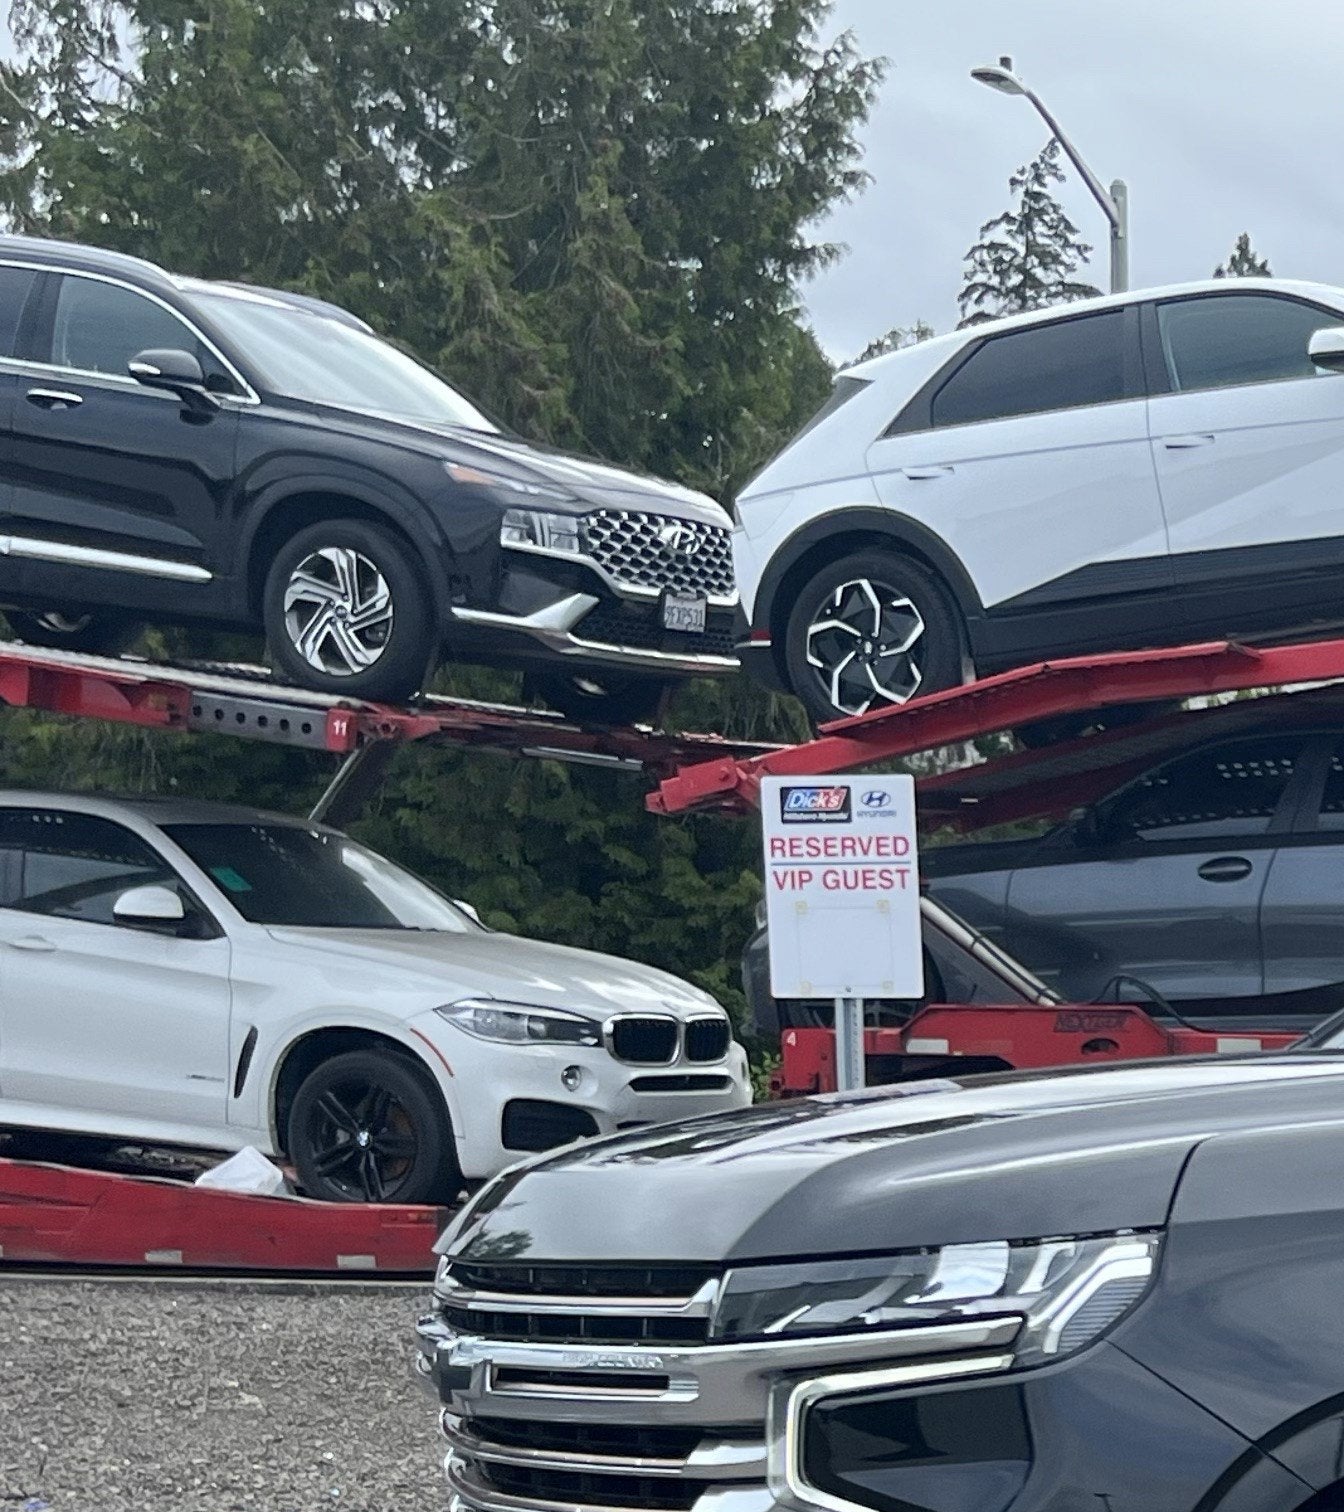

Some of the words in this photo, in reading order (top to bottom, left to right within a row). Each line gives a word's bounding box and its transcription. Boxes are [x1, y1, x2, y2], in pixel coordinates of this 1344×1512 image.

[333, 720, 347, 736] 11
[770, 835, 910, 857] RESERVED
[773, 869, 813, 890] VIP
[822, 868, 911, 890] GUEST
